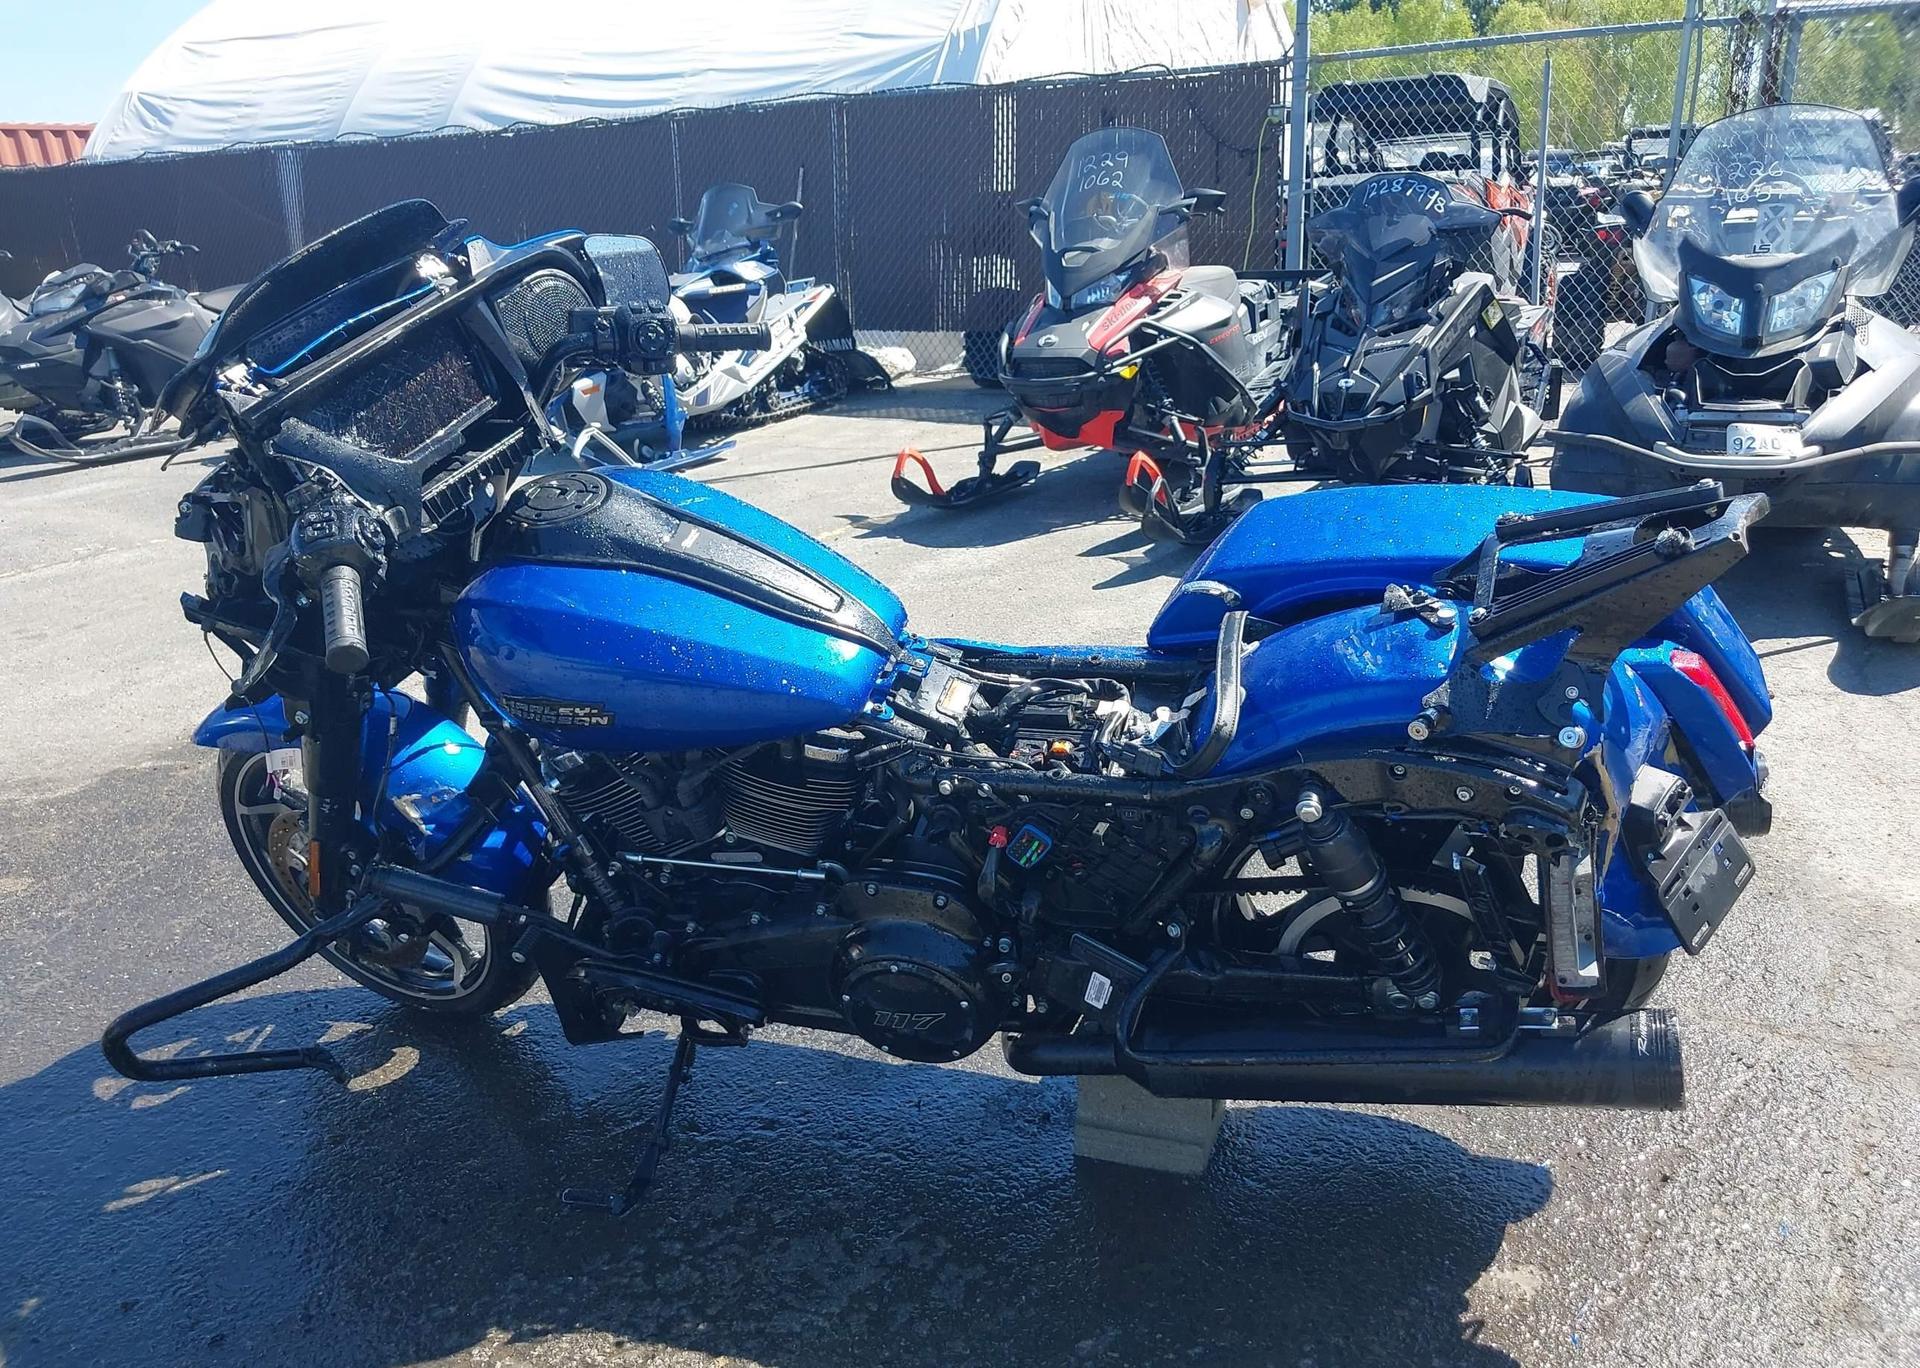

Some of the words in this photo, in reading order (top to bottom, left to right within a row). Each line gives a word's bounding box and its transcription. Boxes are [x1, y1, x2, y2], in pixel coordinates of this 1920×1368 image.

[1077, 151, 1129, 178] 1229
[1079, 169, 1124, 193] 1062
[873, 1010, 947, 1030] 117
